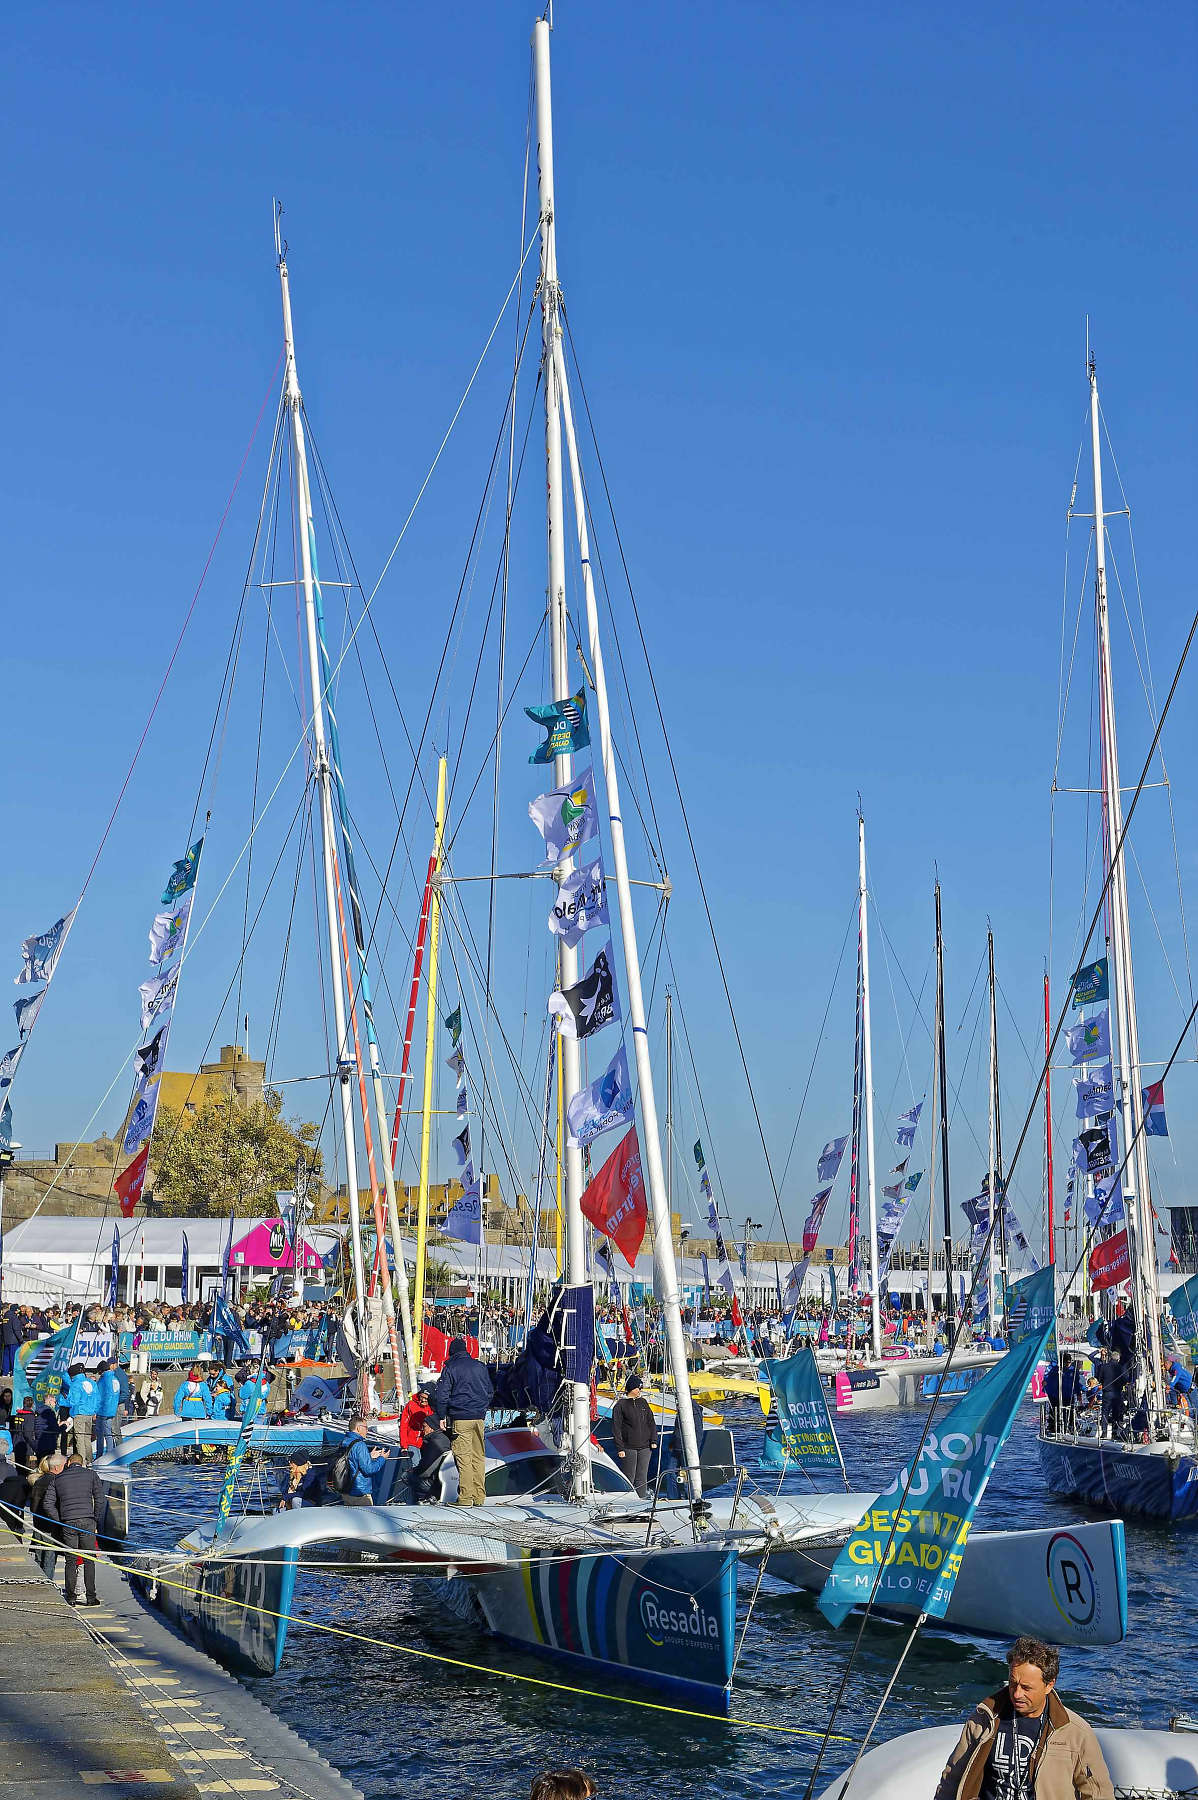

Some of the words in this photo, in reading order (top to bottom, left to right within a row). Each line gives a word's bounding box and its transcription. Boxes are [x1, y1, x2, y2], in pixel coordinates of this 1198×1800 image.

[73, 1340, 110, 1358] UZUKI
[788, 1400, 824, 1416] ROUTE
[797, 1415, 828, 1429] RHUM
[645, 1601, 719, 1638] Resadia
